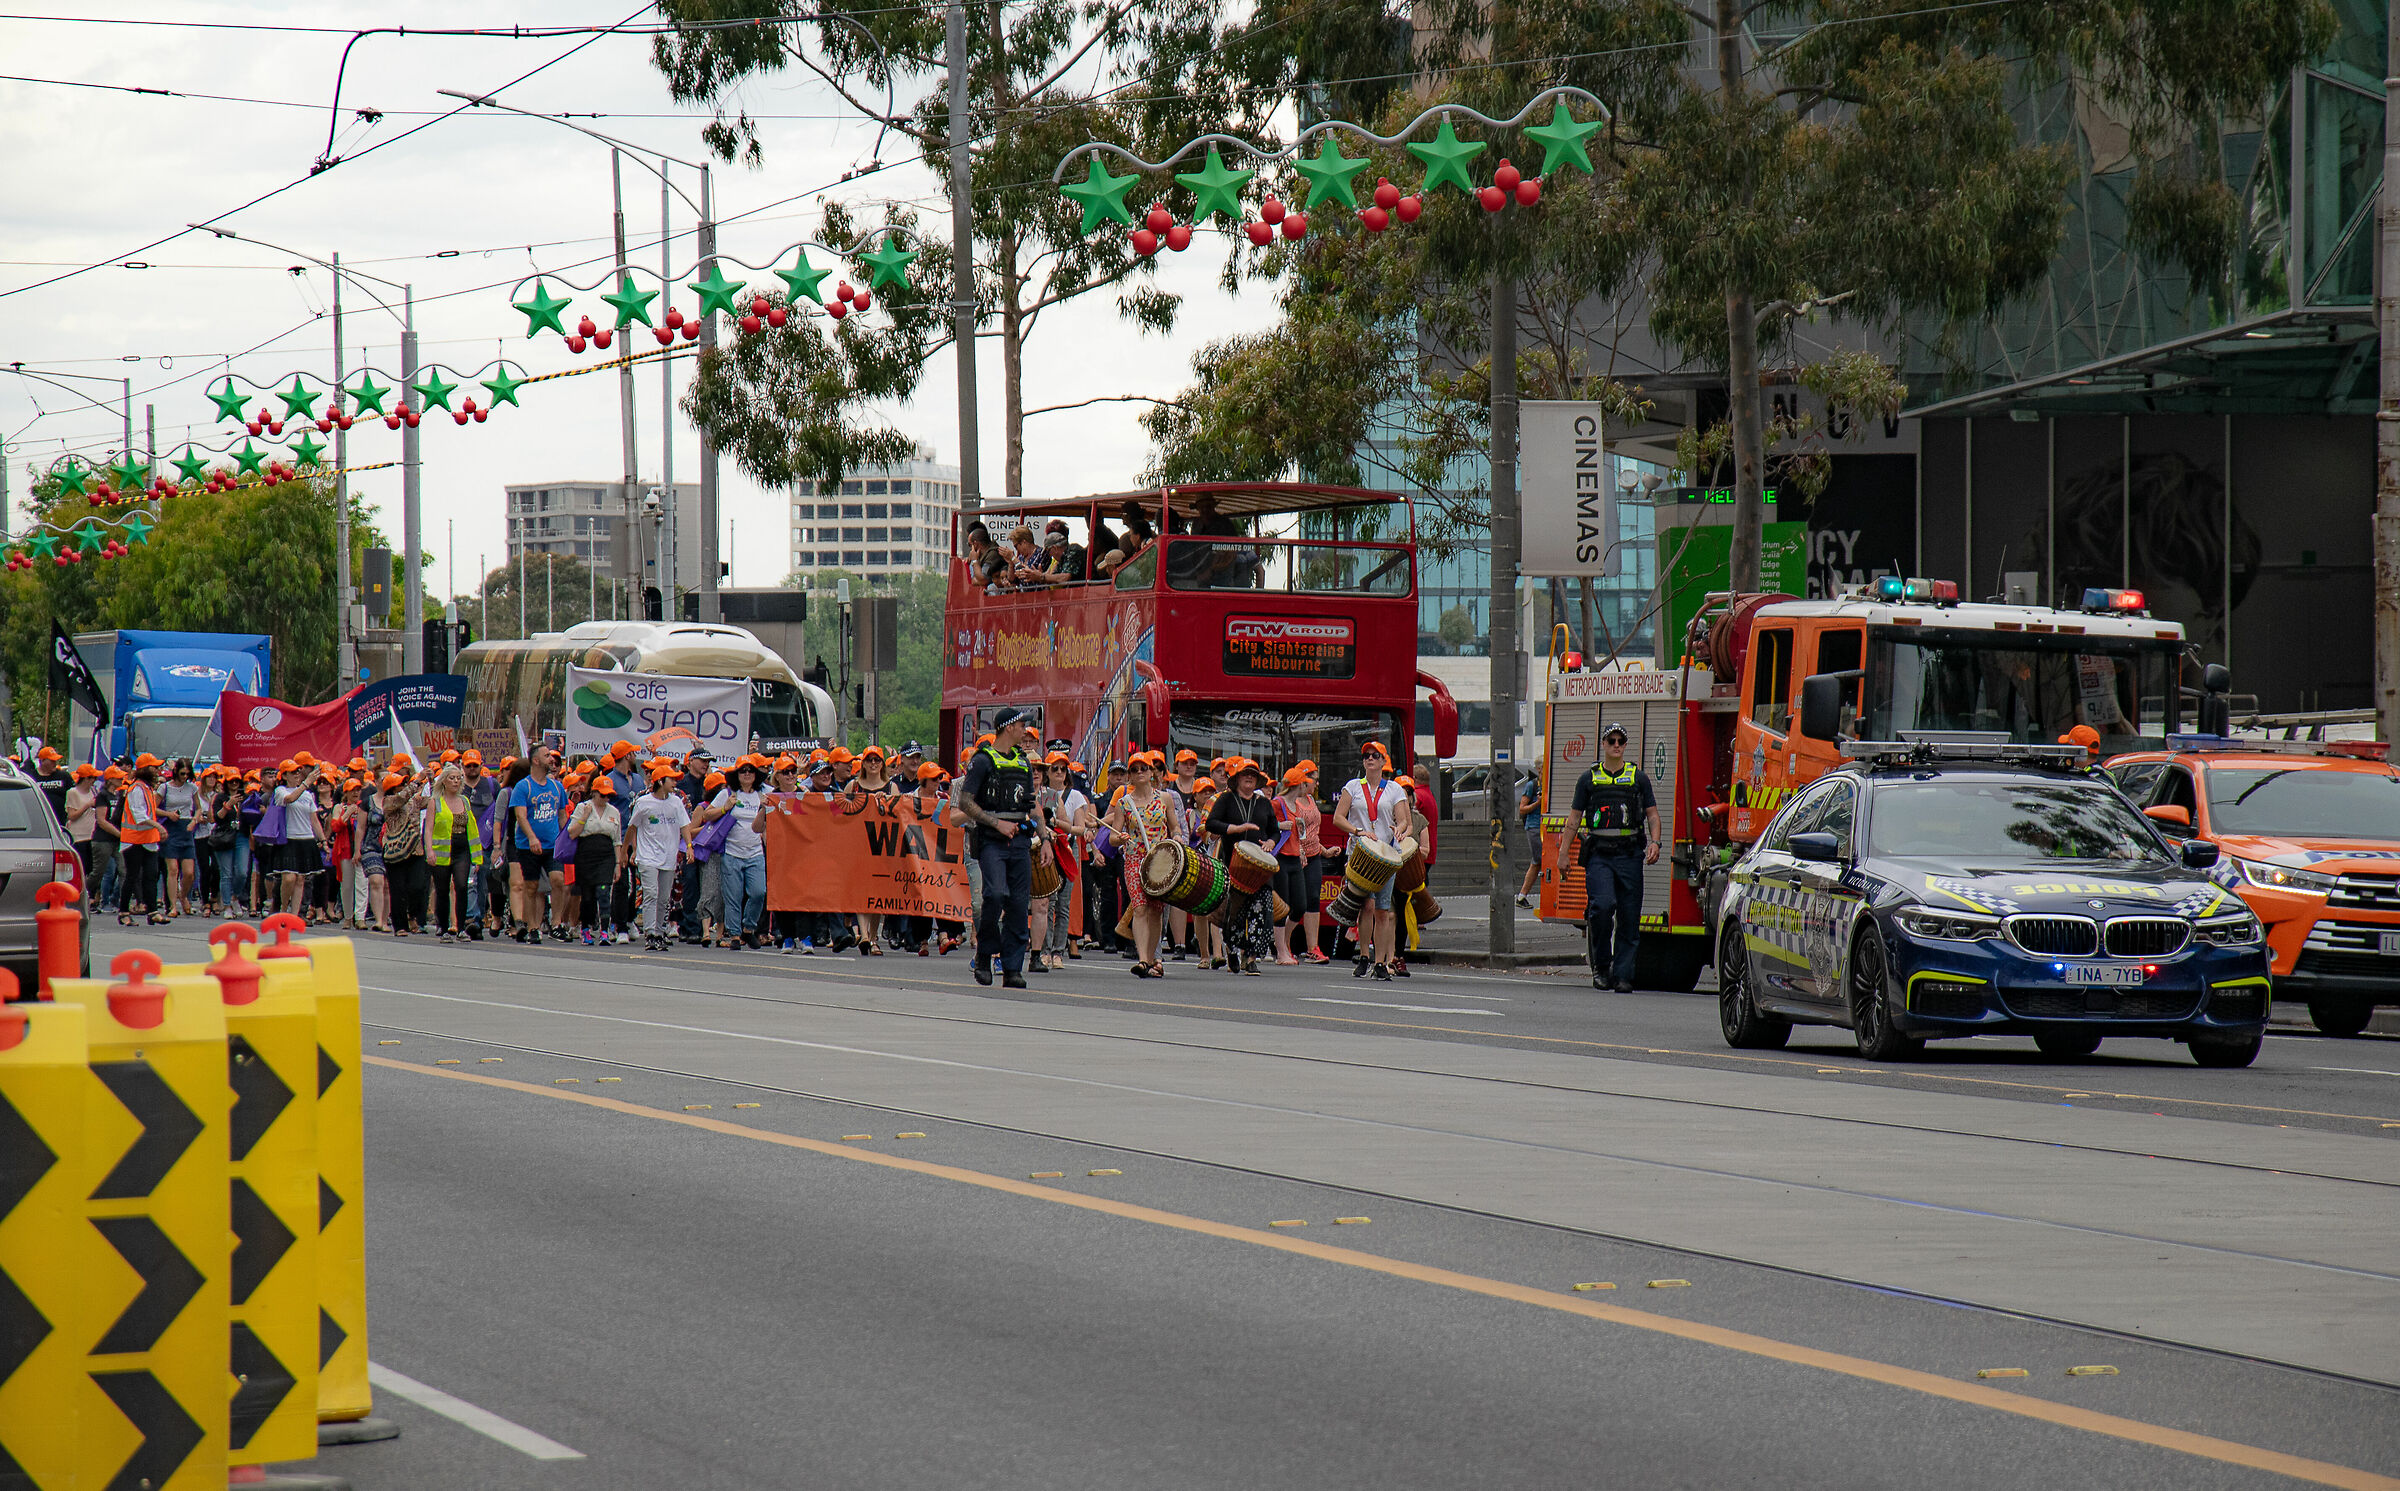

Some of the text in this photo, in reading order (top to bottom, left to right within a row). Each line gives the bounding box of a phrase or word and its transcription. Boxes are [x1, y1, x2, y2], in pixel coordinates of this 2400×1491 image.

[1574, 415, 1599, 563] CINEMAS
[988, 520, 1040, 530] CINEMAS
[1762, 560, 1780, 569] Edge
[1289, 627, 1345, 635] GROUP
[1230, 639, 1345, 658] City Sightseeing
[1251, 655, 1321, 671] Melbourne
[625, 681, 668, 700] safe
[1564, 674, 1664, 697] METROPOLITAN FIRE BRIGADE
[354, 693, 387, 717] DOMESTIC
[398, 693, 457, 704] VOICE AGAINST
[398, 701, 437, 710] VIOLENCE
[354, 701, 386, 724] VIOLENCE
[1224, 709, 1343, 724] Garden of Eden
[354, 710, 385, 732] VICTORIA
[637, 702, 739, 741] steps
[235, 732, 254, 740] Good
[424, 729, 455, 753] ABUSE
[477, 731, 510, 740] FAMILY
[476, 739, 514, 749] VIOLENCE
[766, 740, 820, 751] #callitout
[480, 748, 510, 758] APPENS
[533, 809, 558, 820] HAPPY
[864, 821, 965, 864] WAL
[894, 867, 957, 895] against
[867, 897, 973, 917] FAMILY VIOLENC
